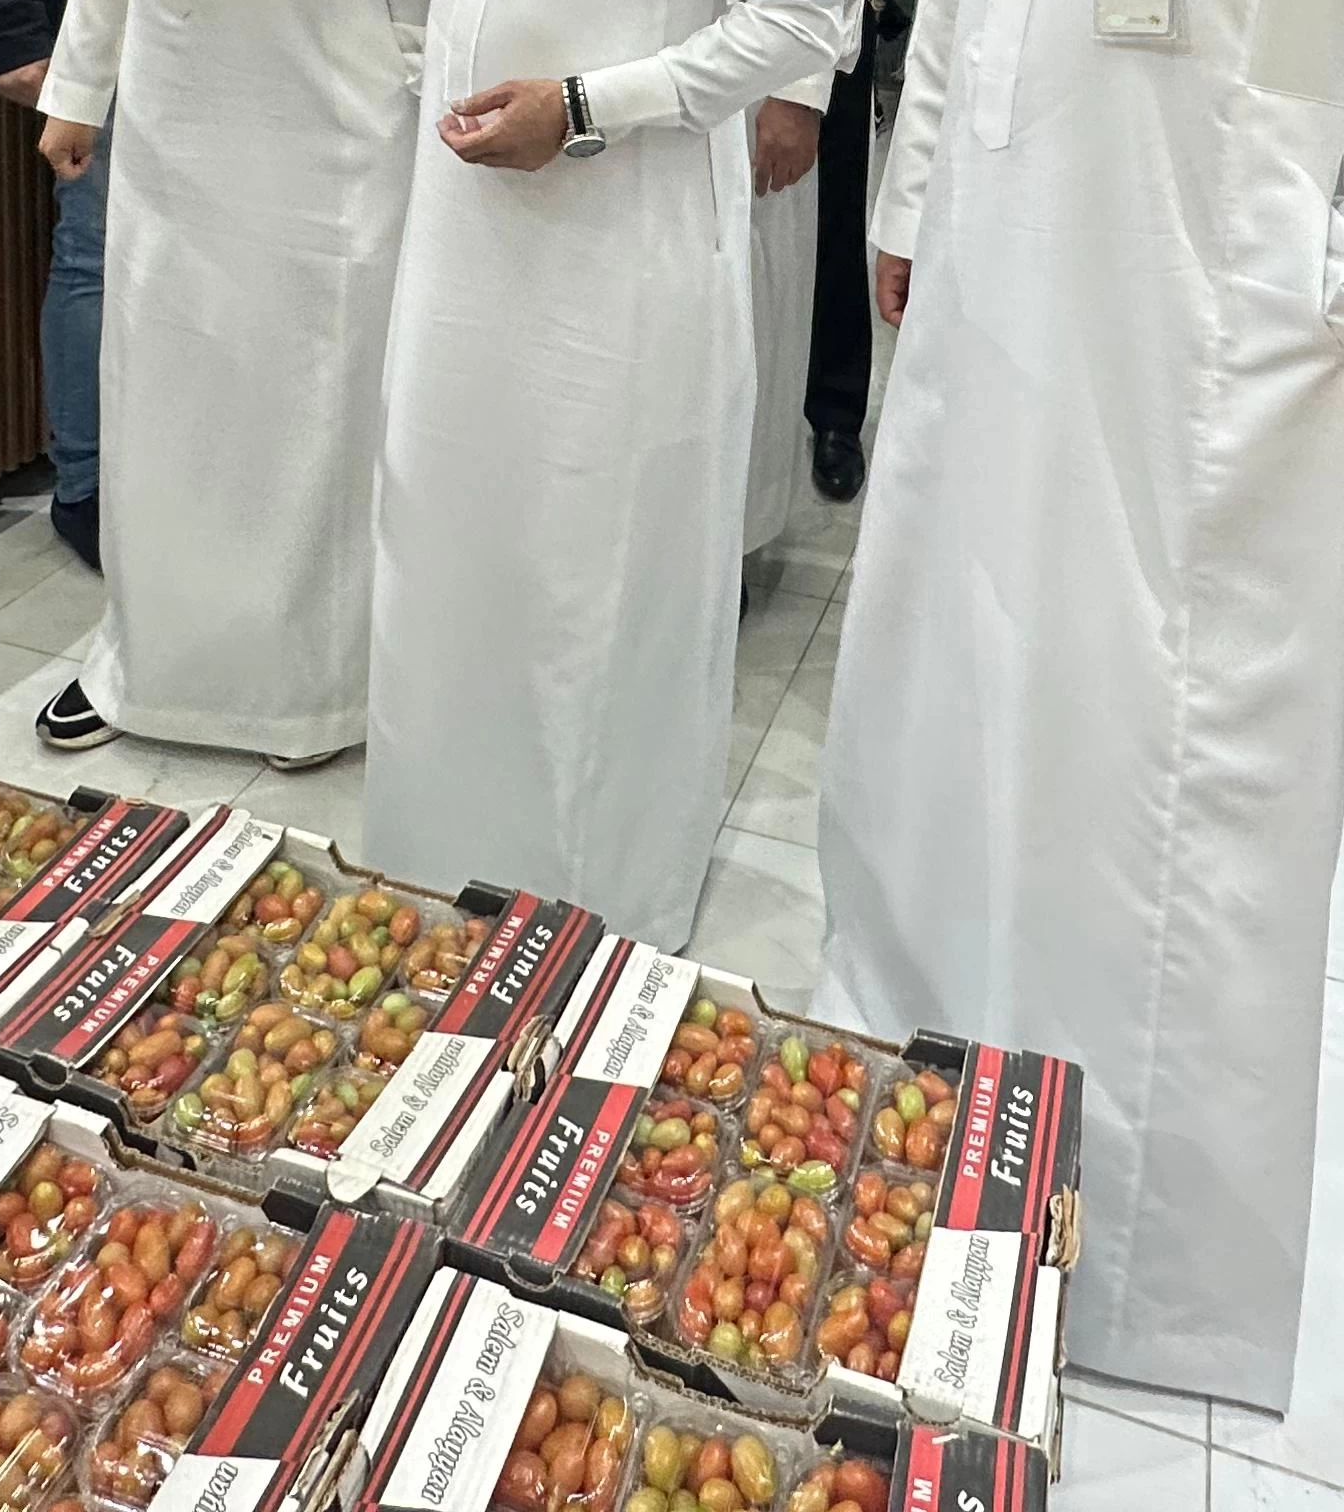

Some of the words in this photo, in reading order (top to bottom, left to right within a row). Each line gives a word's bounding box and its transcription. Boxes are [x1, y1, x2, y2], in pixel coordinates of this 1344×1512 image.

[41, 818, 115, 889] PREMIUM
[62, 824, 139, 895] Fruits
[226, 820, 264, 859] Salem
[53, 944, 137, 1022] Fruits
[79, 953, 160, 1036] PREMIUM
[465, 915, 524, 995] PREMIUM
[490, 924, 554, 1005] Fruits
[639, 958, 674, 1004] Salem
[602, 1016, 648, 1080] Alayyan
[369, 1112, 417, 1158] Salem
[413, 1037, 466, 1098] Alayyan
[962, 1075, 995, 1179] PREMIUM
[990, 1085, 1035, 1187] Fruits
[515, 1114, 584, 1216] Fruits
[552, 1128, 611, 1230] PREMIUM
[950, 1233, 992, 1313] Alayyan
[248, 1254, 332, 1385] PREMIUM
[279, 1266, 369, 1398] Fruits
[477, 1303, 525, 1375] Salem
[934, 1328, 974, 1388] Salem
[421, 1400, 485, 1505] Alayyan
